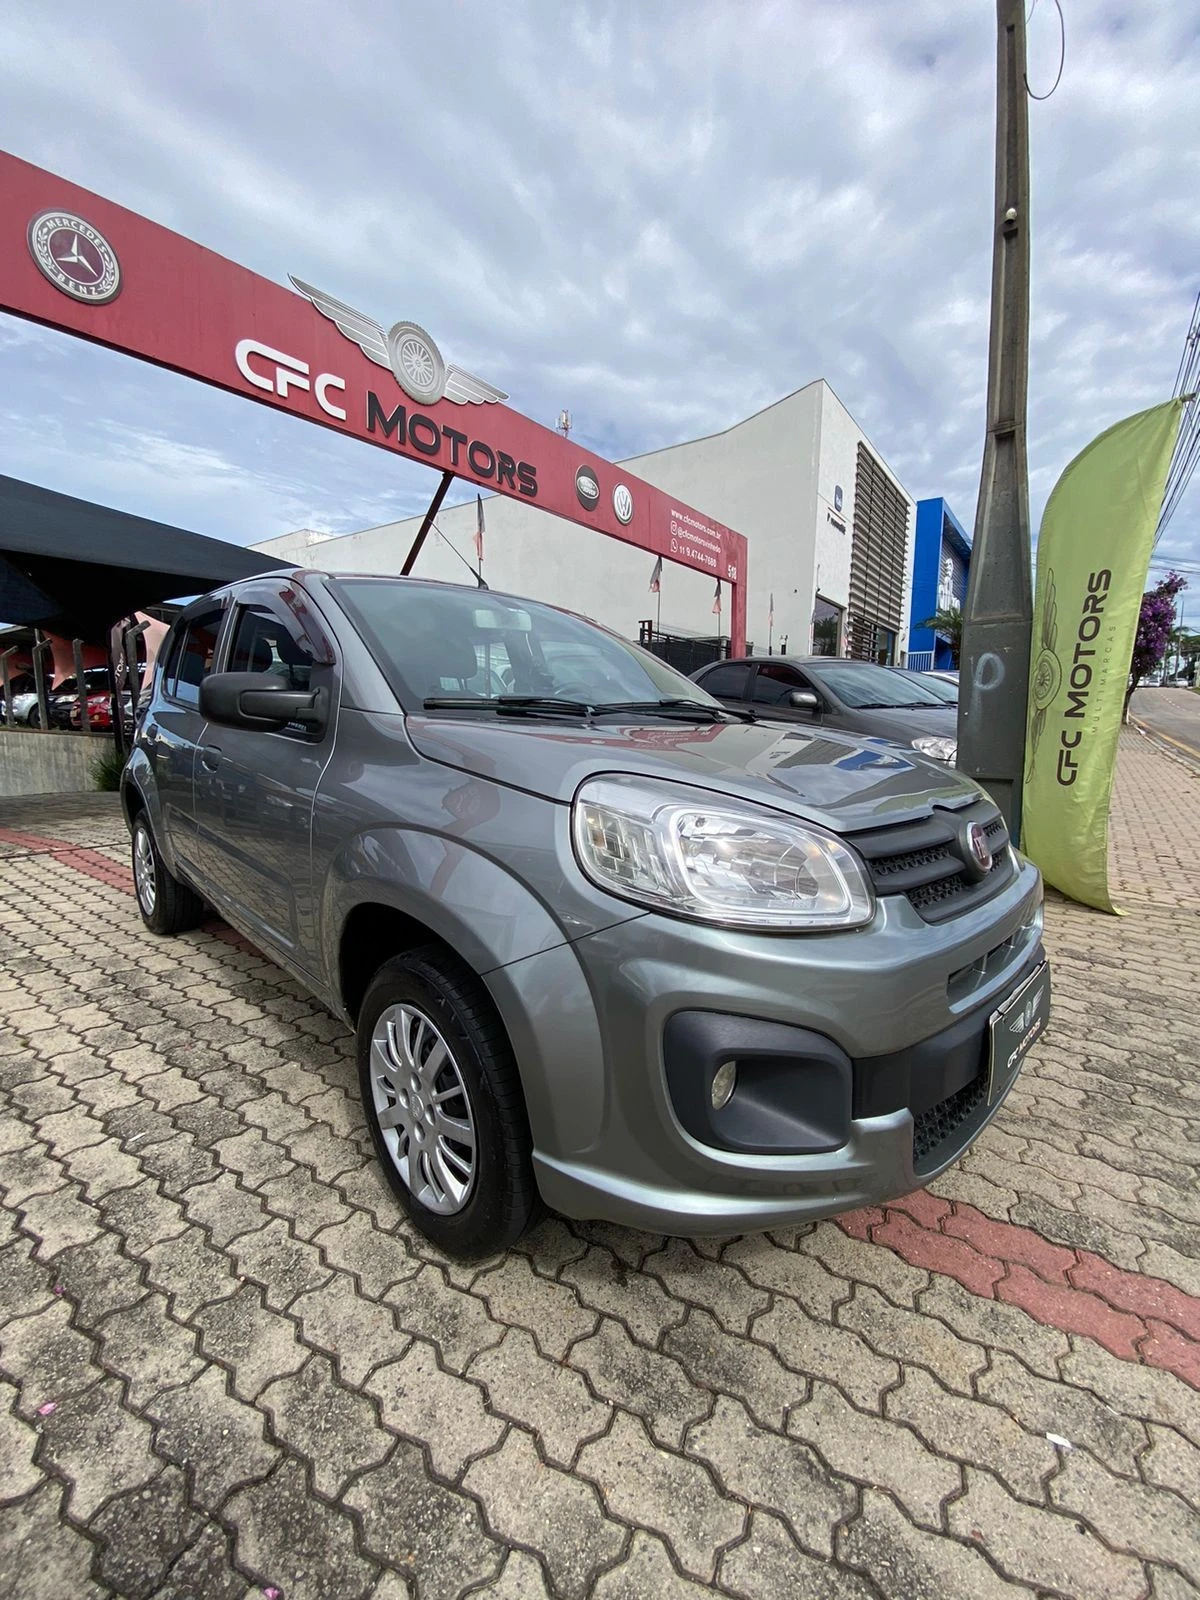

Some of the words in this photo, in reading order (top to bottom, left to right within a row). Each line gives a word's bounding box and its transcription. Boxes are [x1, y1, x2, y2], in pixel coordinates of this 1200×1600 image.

[46, 217, 107, 253] MERCEDES
[57, 273, 99, 295] BENZ
[235, 339, 346, 421] CFC
[366, 391, 538, 498] MOTORS
[1064, 569, 1112, 718] MOTORS
[1092, 625, 1117, 733] MULTIMARCAS
[1056, 730, 1082, 786] CFC
